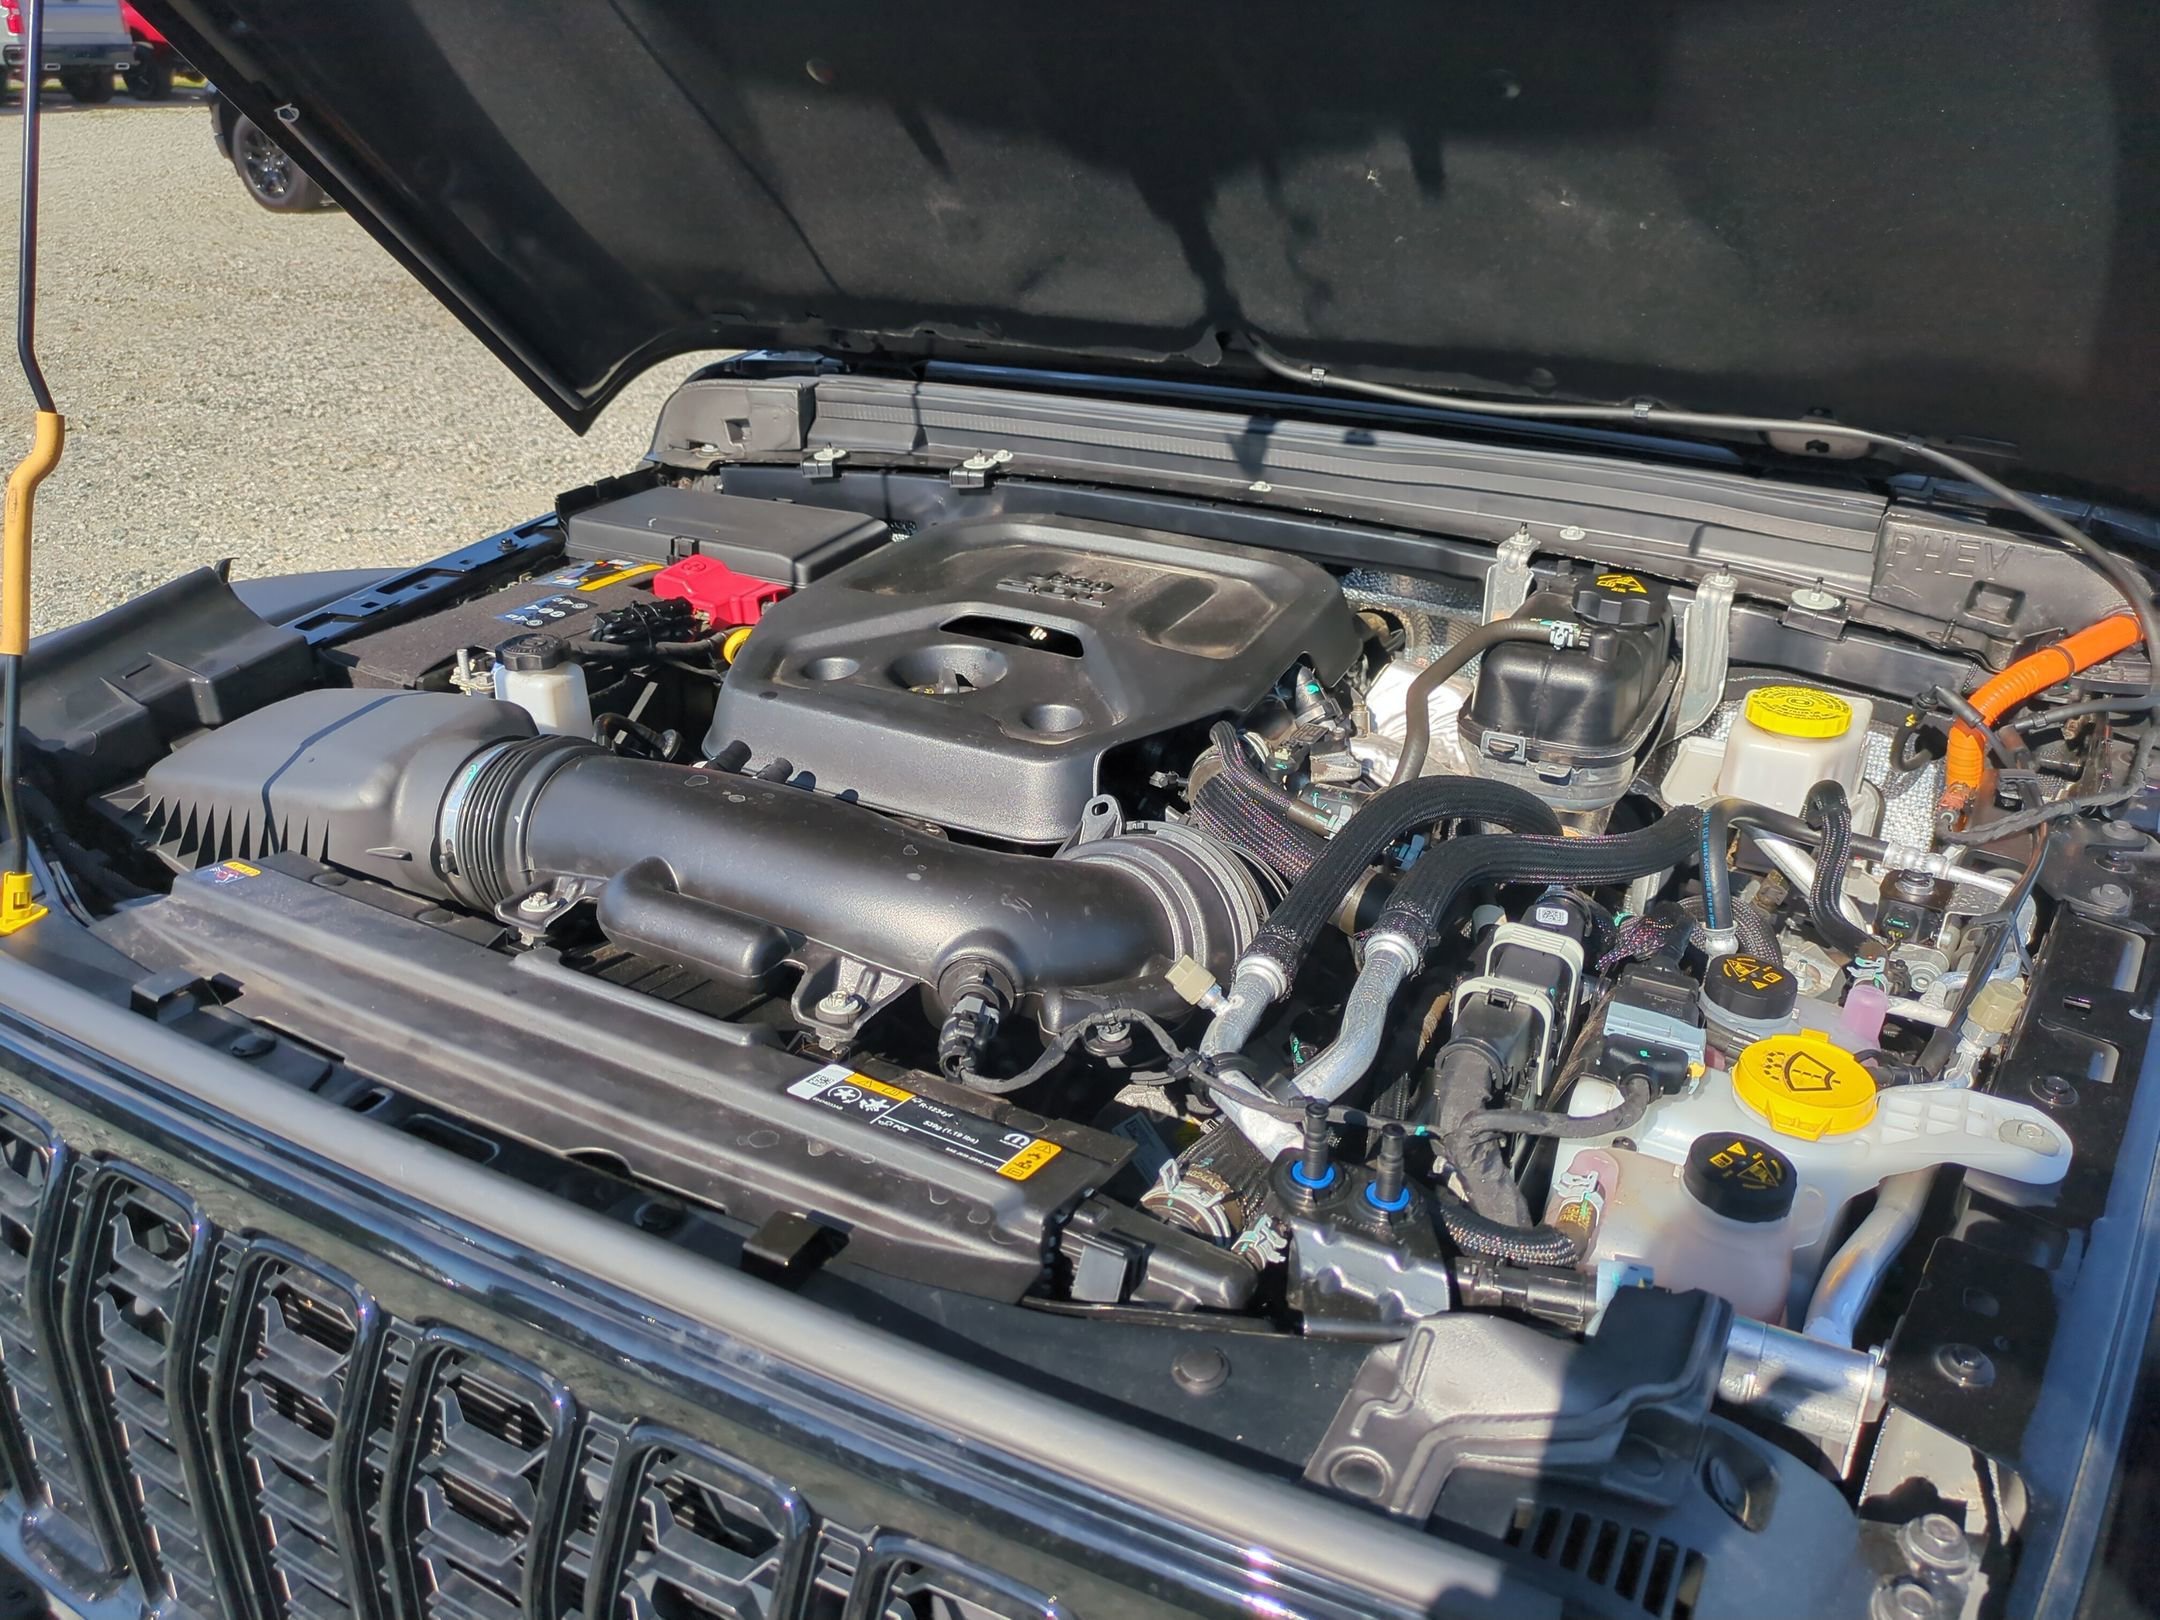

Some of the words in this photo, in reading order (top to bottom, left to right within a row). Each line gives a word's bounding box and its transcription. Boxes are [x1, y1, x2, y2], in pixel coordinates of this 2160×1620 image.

[1886, 532, 2015, 580] PHEV
[1027, 571, 1115, 595] Jeep
[918, 1103, 956, 1119] R-1234yf
